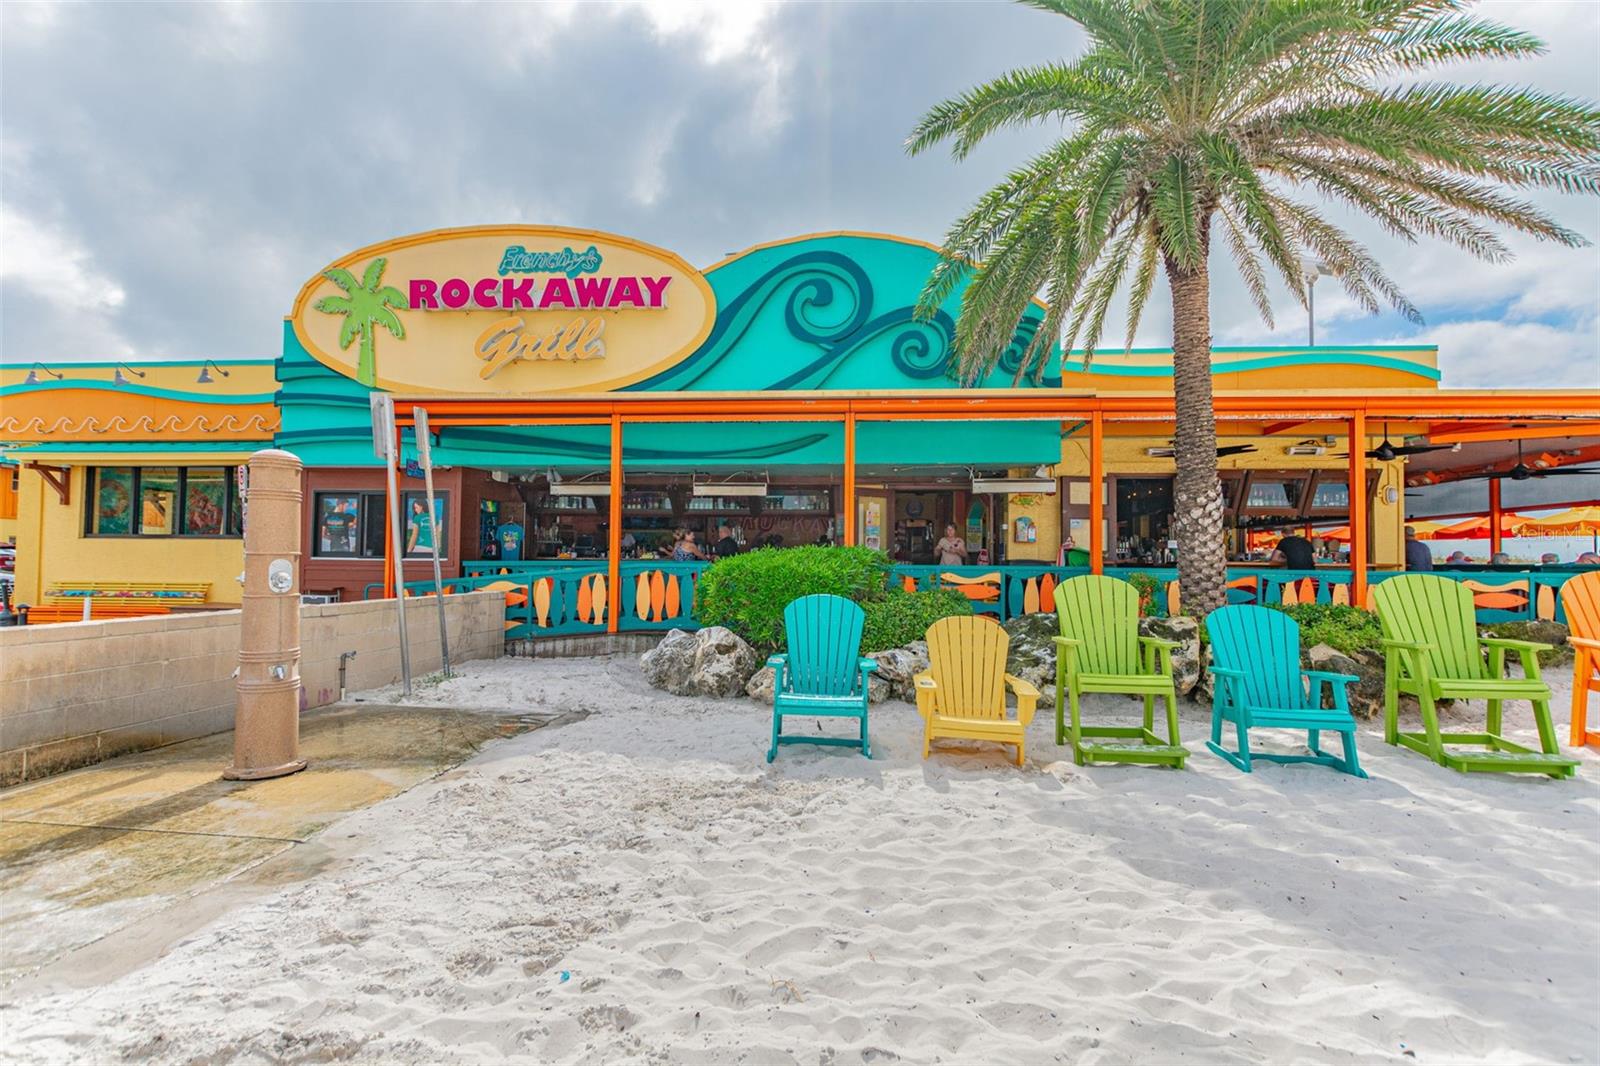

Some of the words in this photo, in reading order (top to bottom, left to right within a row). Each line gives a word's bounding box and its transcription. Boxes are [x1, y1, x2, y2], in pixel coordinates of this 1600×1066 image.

[499, 245, 602, 277] Frenchy's
[409, 276, 672, 310] ROCKAWAY
[474, 316, 605, 380] Grill
